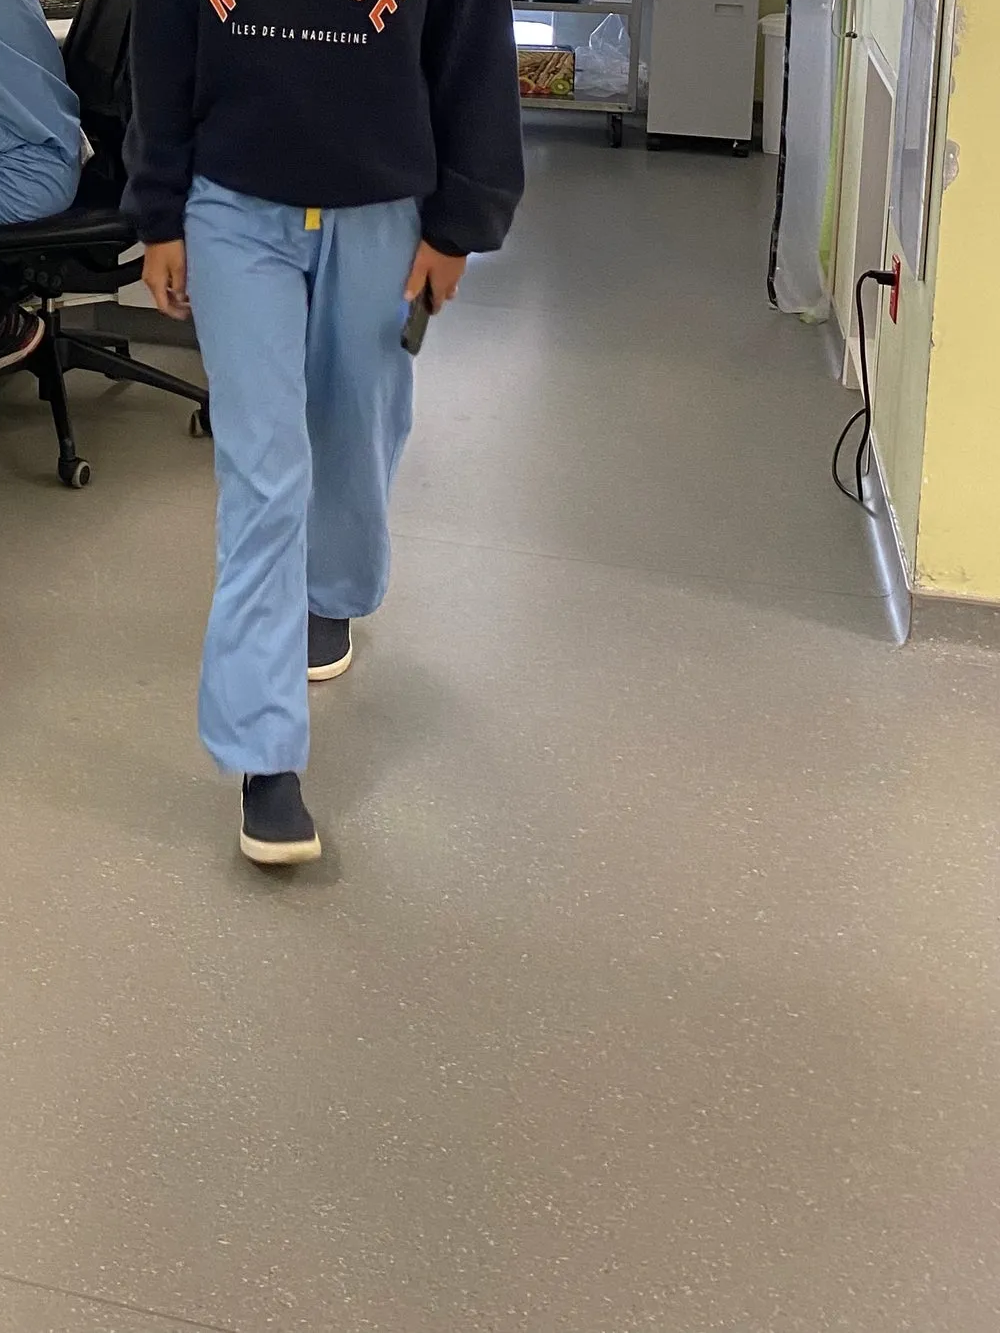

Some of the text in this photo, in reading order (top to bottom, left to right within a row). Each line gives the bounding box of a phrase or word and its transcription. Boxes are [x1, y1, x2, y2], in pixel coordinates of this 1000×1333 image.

[231, 22, 368, 44] ÎLES DE LA MADELEINE
